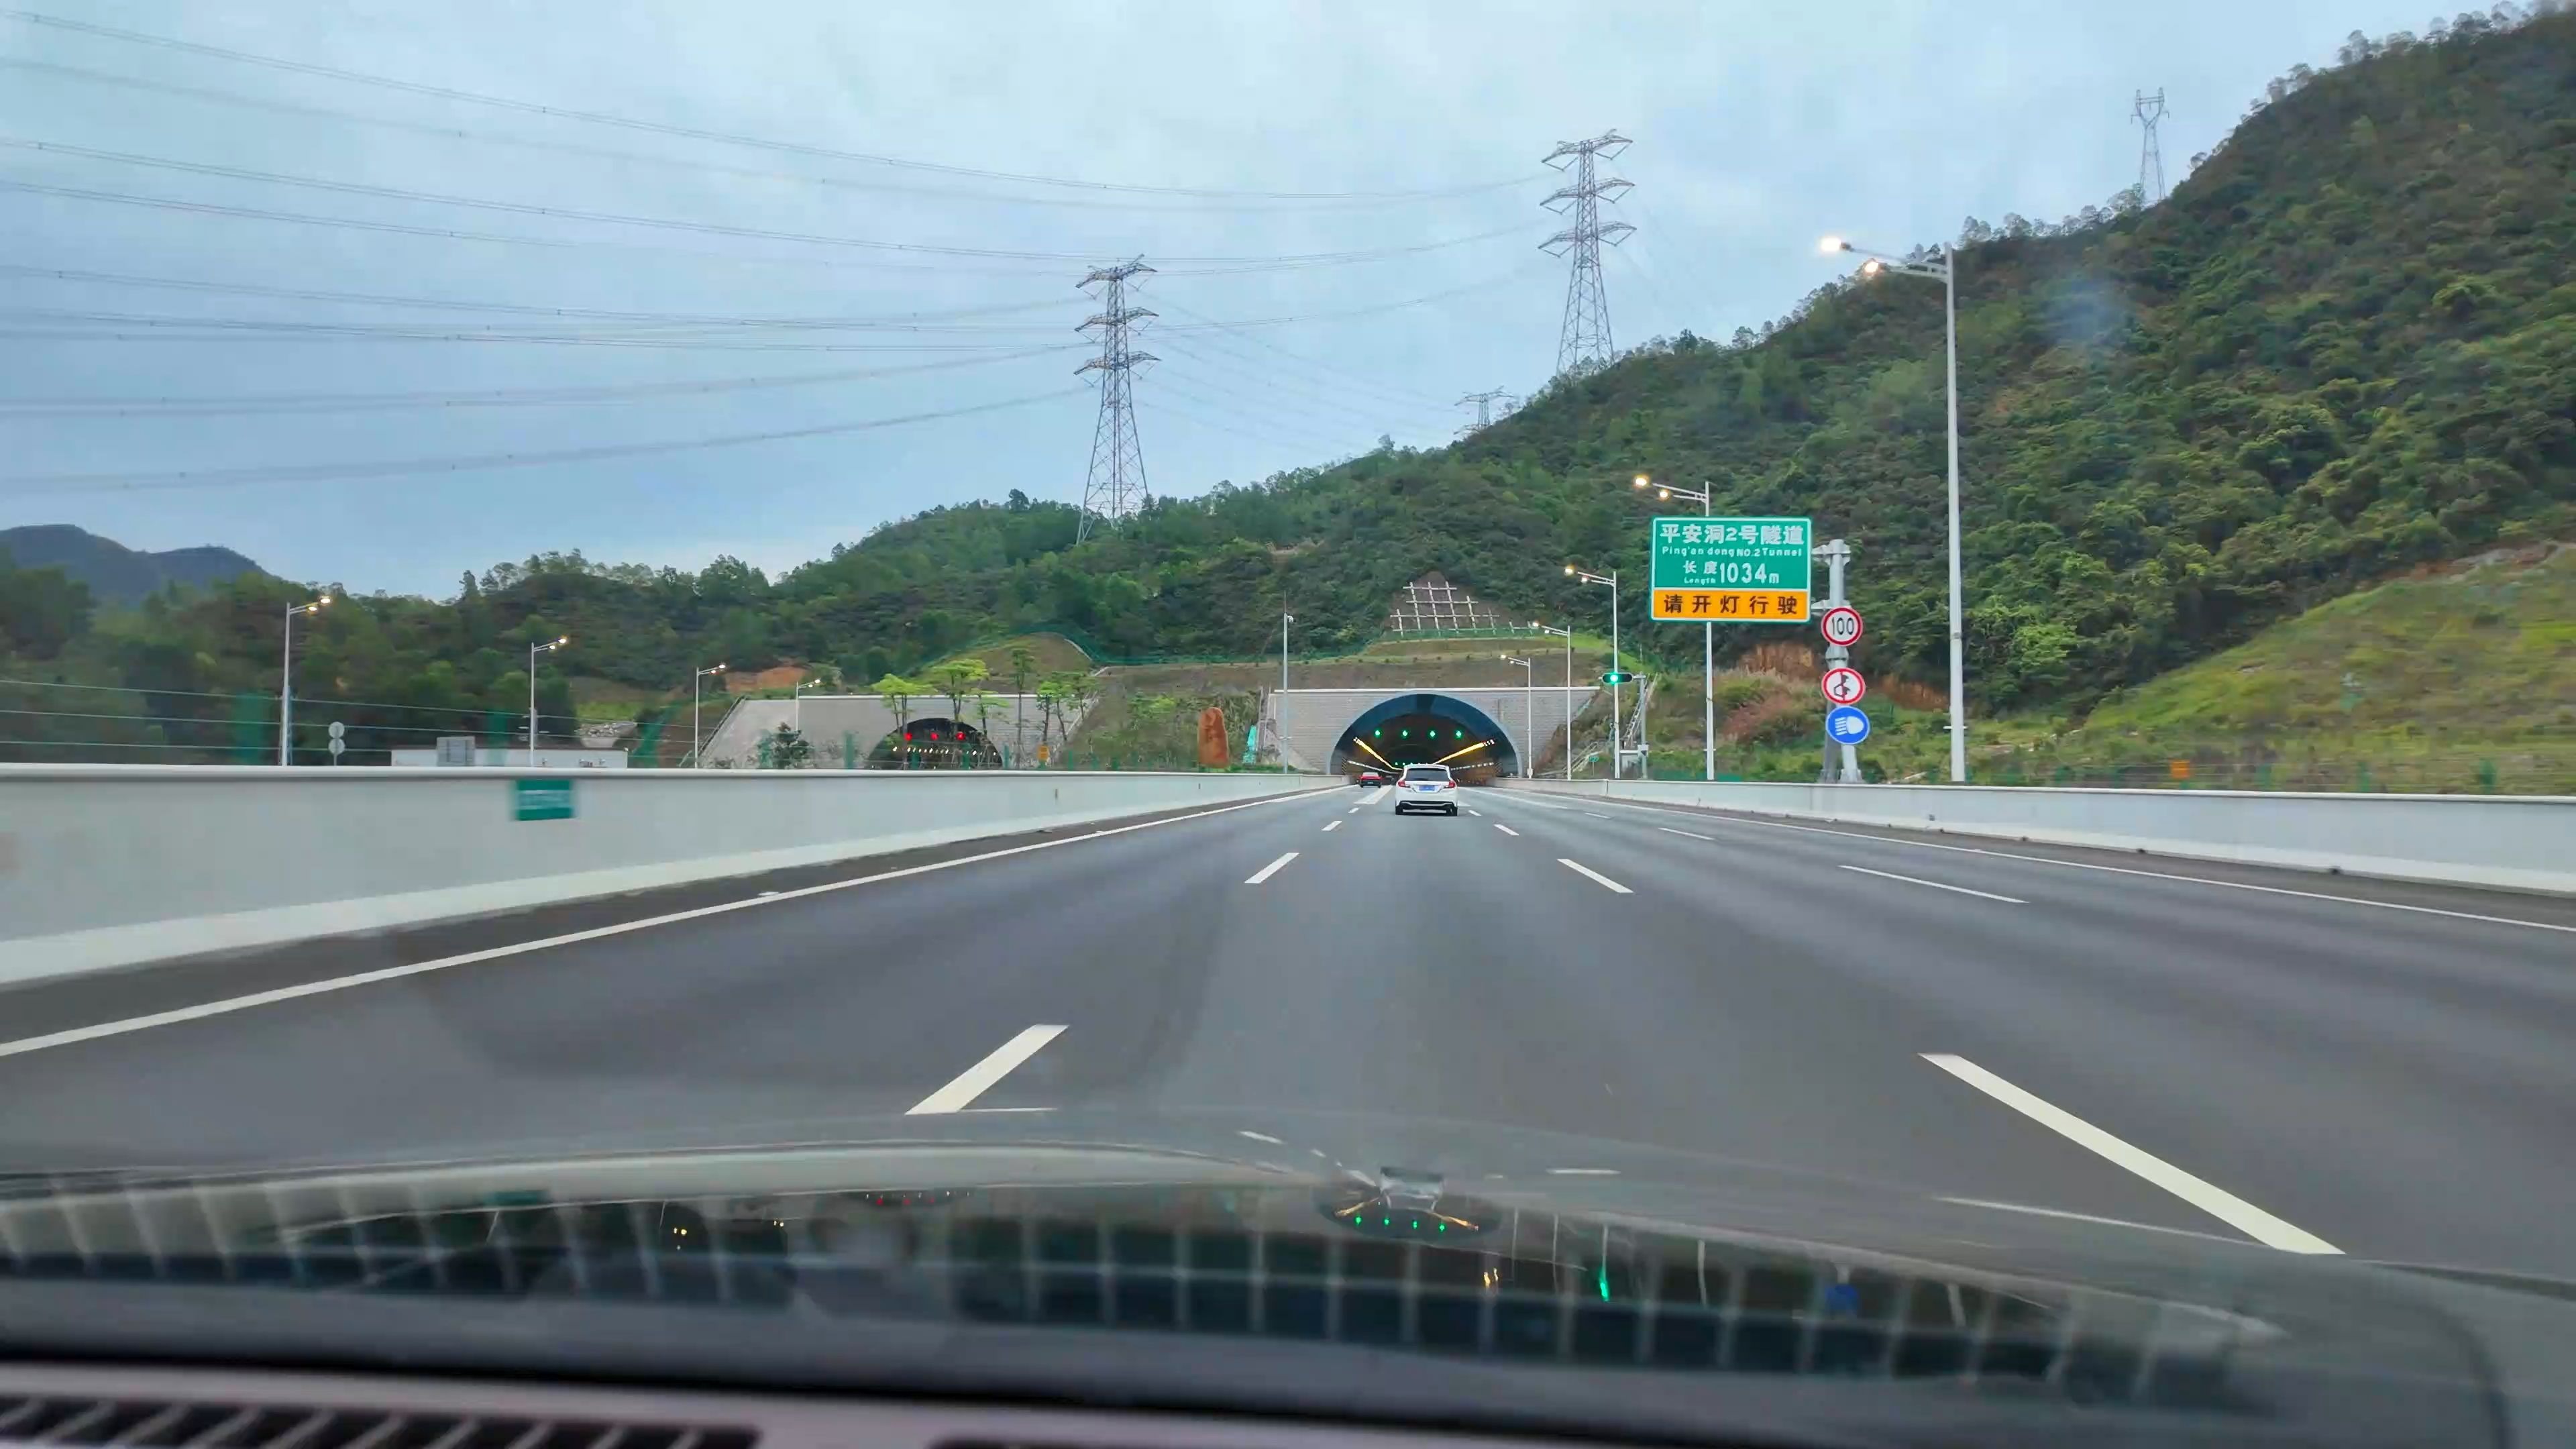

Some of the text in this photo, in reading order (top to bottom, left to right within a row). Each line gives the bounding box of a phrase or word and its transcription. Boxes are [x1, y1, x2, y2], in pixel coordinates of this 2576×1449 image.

[1660, 523, 1805, 545] 平安洞2号隧道
[1707, 547, 1735, 557] dong
[1762, 547, 1802, 556] Tunnel
[1683, 560, 1718, 575] 长度
[1684, 577, 1716, 586] Length
[1664, 594, 1798, 614] 请开灯行驶
[1831, 617, 1854, 635] 100
